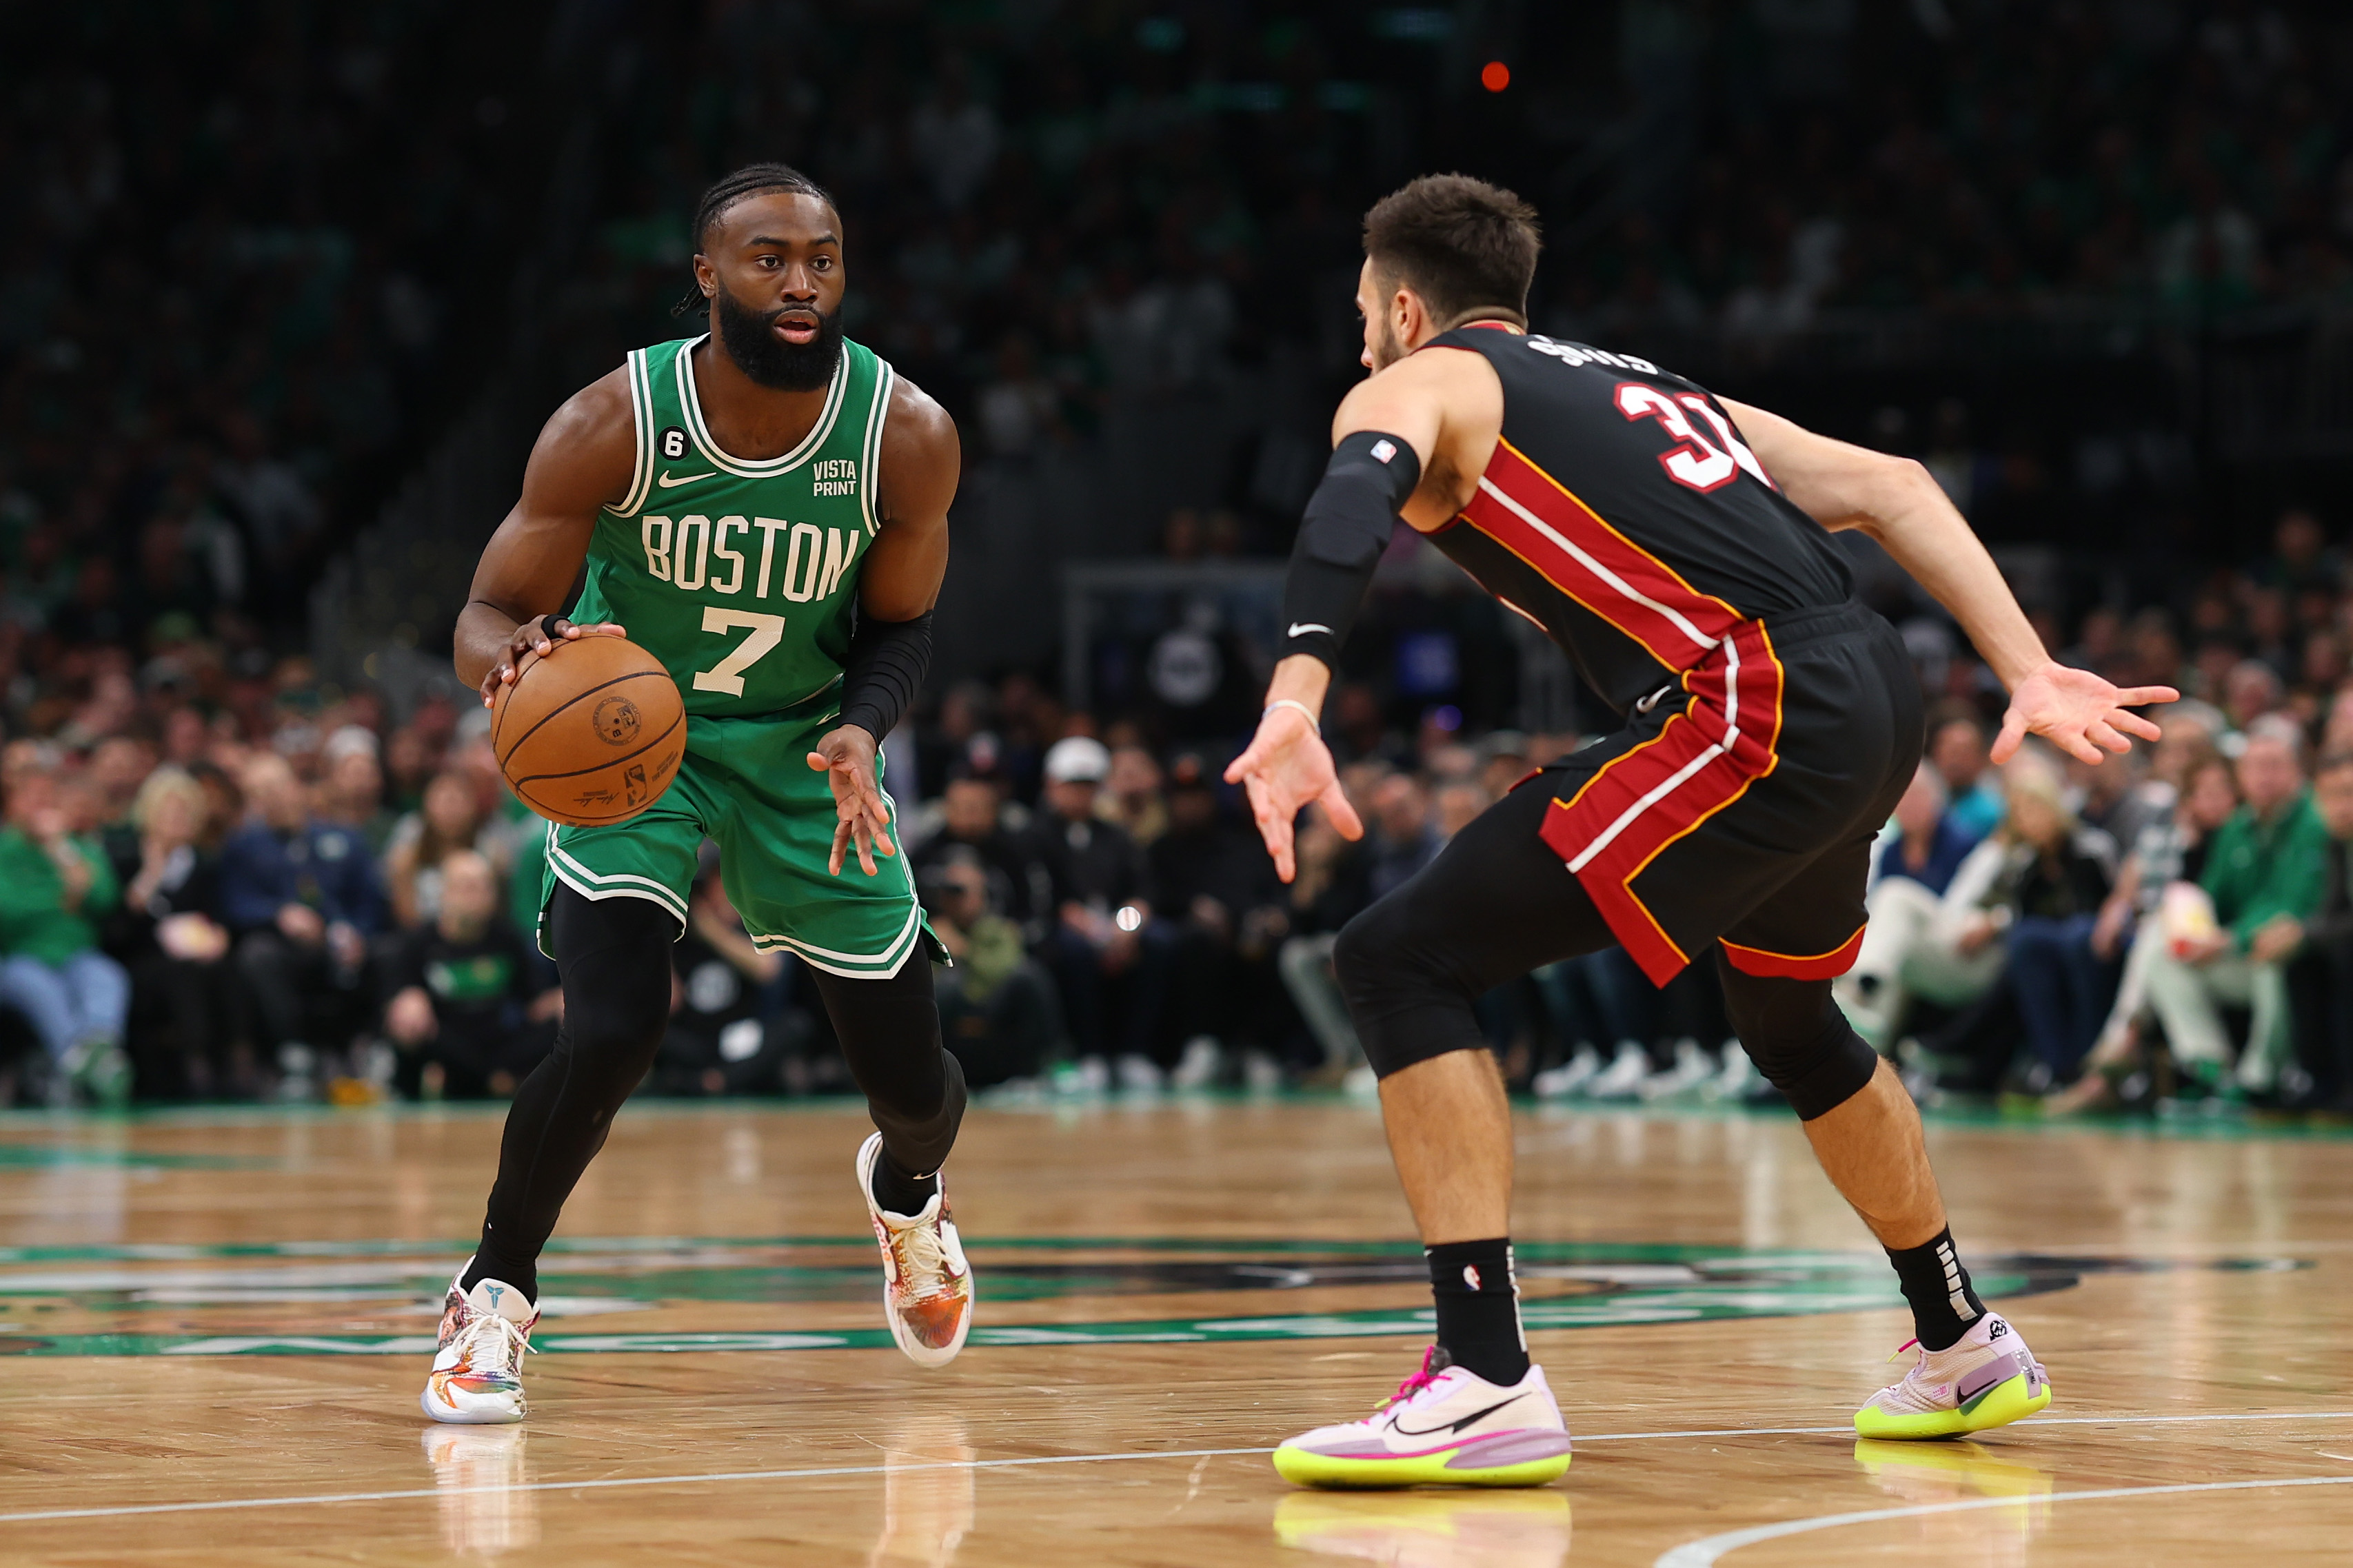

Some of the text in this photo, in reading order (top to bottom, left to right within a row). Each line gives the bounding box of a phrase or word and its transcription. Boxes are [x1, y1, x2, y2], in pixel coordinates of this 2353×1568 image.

[665, 431, 684, 457] 6
[1613, 382, 1779, 494] 31
[813, 460, 856, 481] VISTA
[813, 480, 856, 496] PRINT
[642, 515, 860, 603] BOSTON
[692, 606, 785, 698] 7
